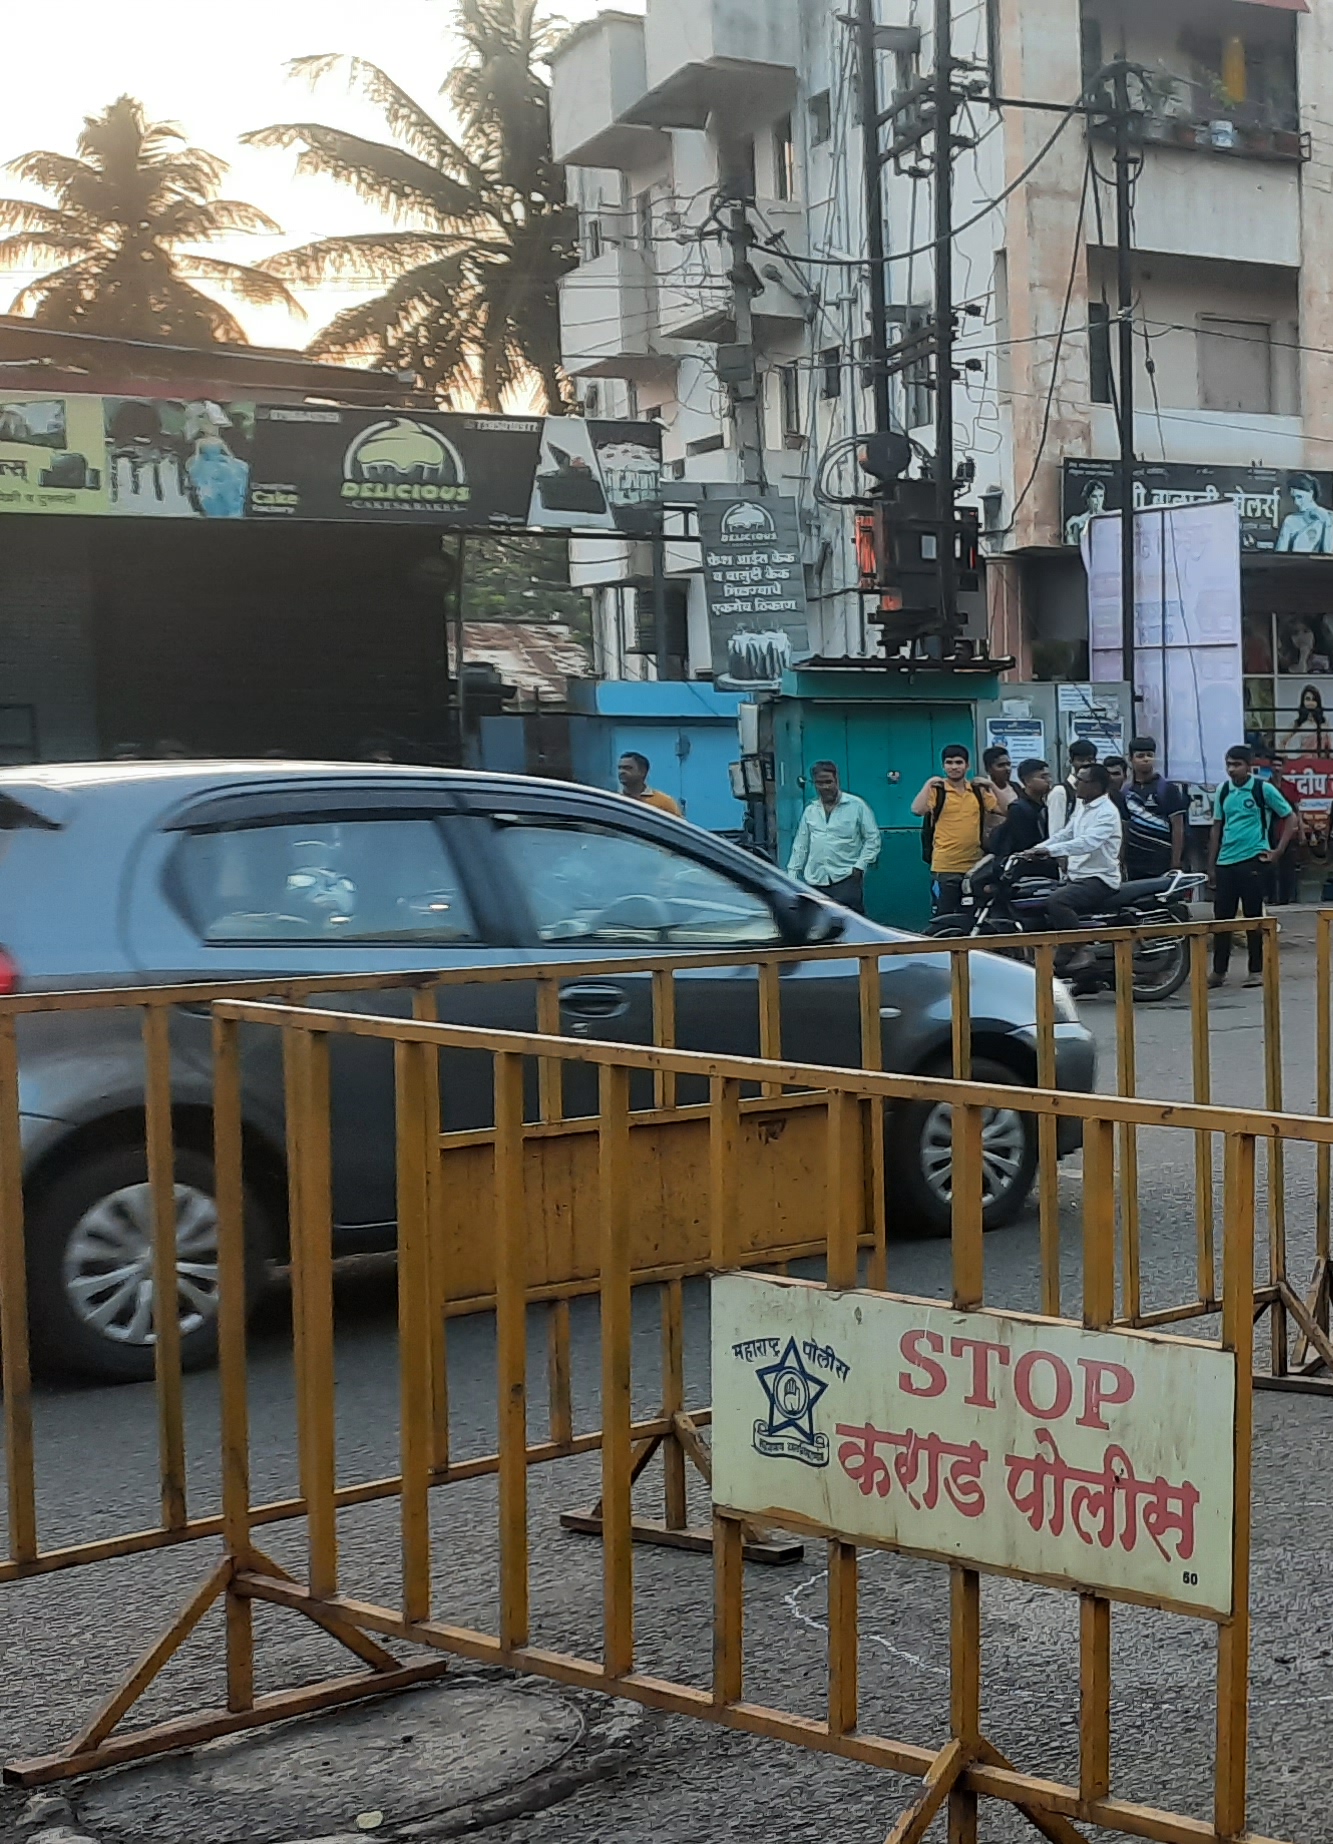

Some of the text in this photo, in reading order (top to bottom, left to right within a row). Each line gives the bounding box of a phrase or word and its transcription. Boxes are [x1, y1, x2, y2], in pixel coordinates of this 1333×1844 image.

[340, 481, 471, 501] DELICIOUS
[802, 1337, 851, 1383] पोलीस
[899, 1329, 1135, 1430] STOP
[836, 1422, 1200, 1562] कराड पोलीस
